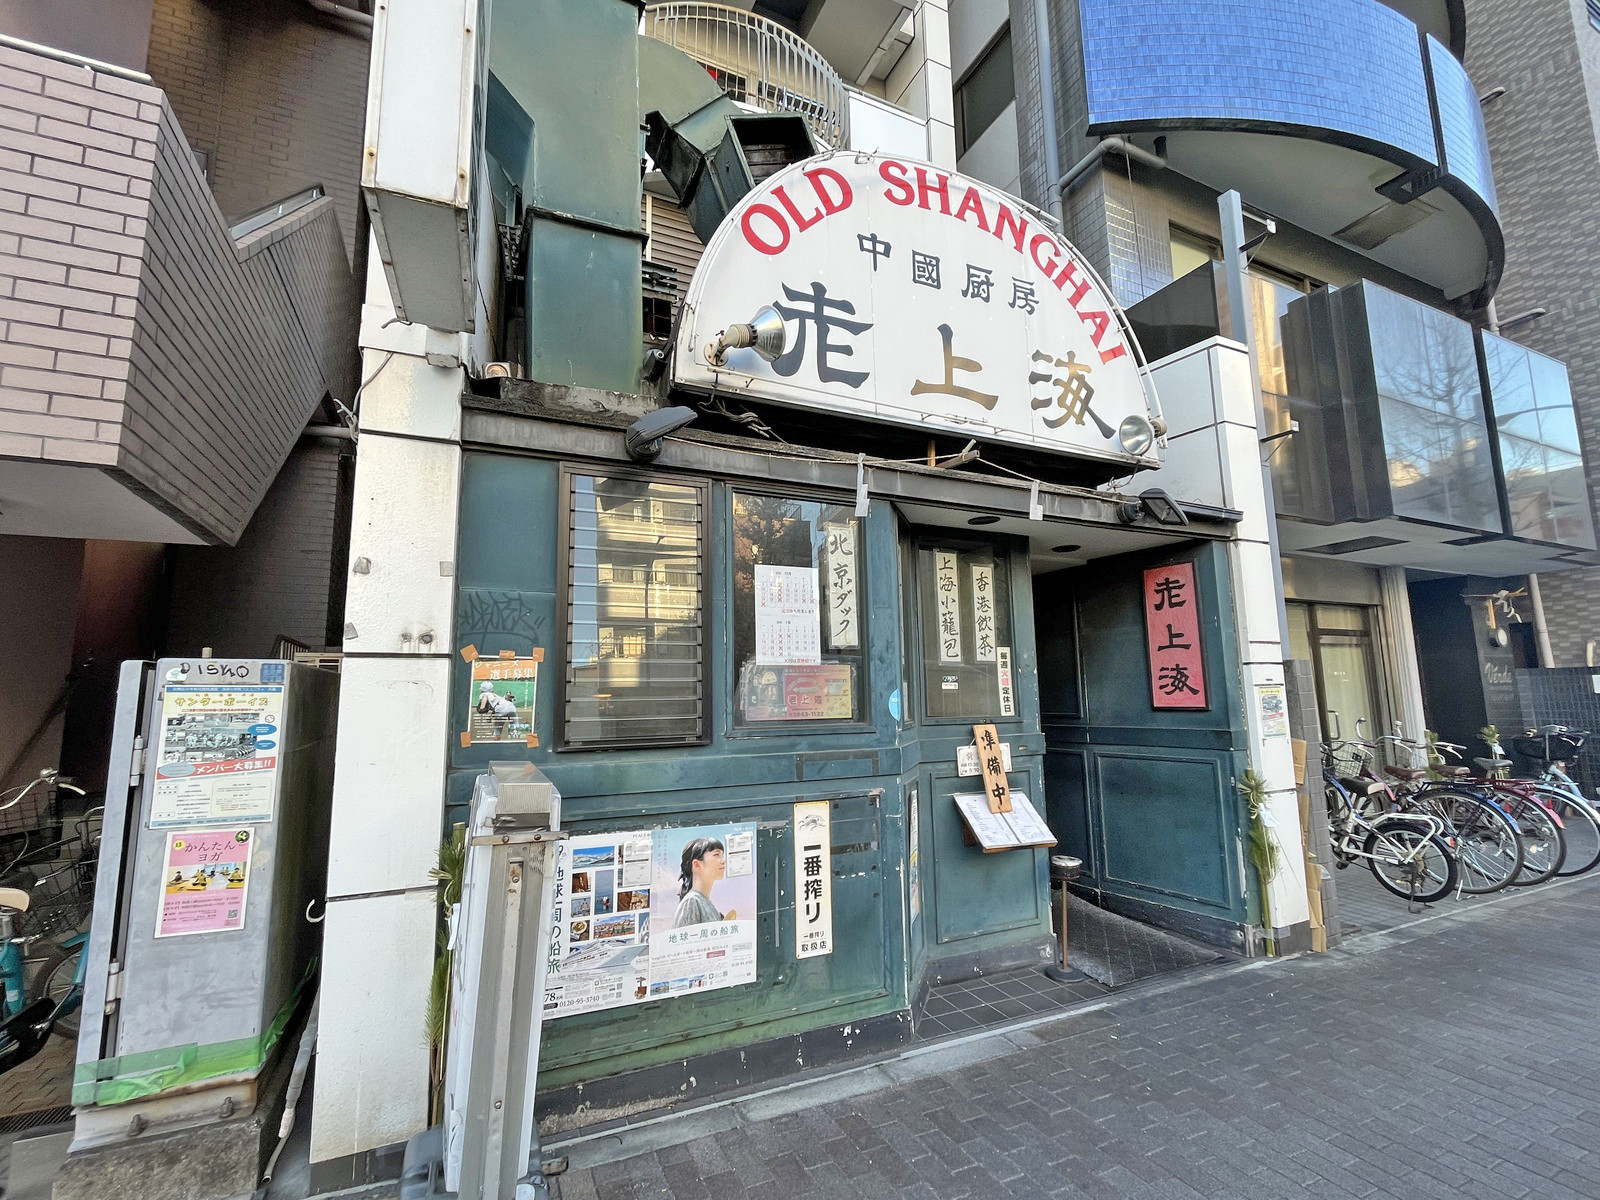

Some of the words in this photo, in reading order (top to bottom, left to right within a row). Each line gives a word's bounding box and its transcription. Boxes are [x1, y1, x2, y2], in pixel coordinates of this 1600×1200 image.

[740, 167, 854, 256] OLD
[878, 160, 1129, 366] SHANGHAI
[856, 233, 1040, 316] 中國厨房
[829, 533, 854, 638] 北京ダック
[938, 556, 959, 660] 上海小籠包
[975, 571, 993, 657] 香港飲茶
[489, 667, 535, 680] 選手募集
[1000, 651, 1012, 714] 毎週火曜定休日
[198, 852, 223, 862] ヨガ
[803, 844, 823, 924] 一番搾り
[668, 924, 739, 944] 地球一周の船旅
[801, 940, 828, 952] 取扱店
[803, 930, 825, 939] 一番搾り
